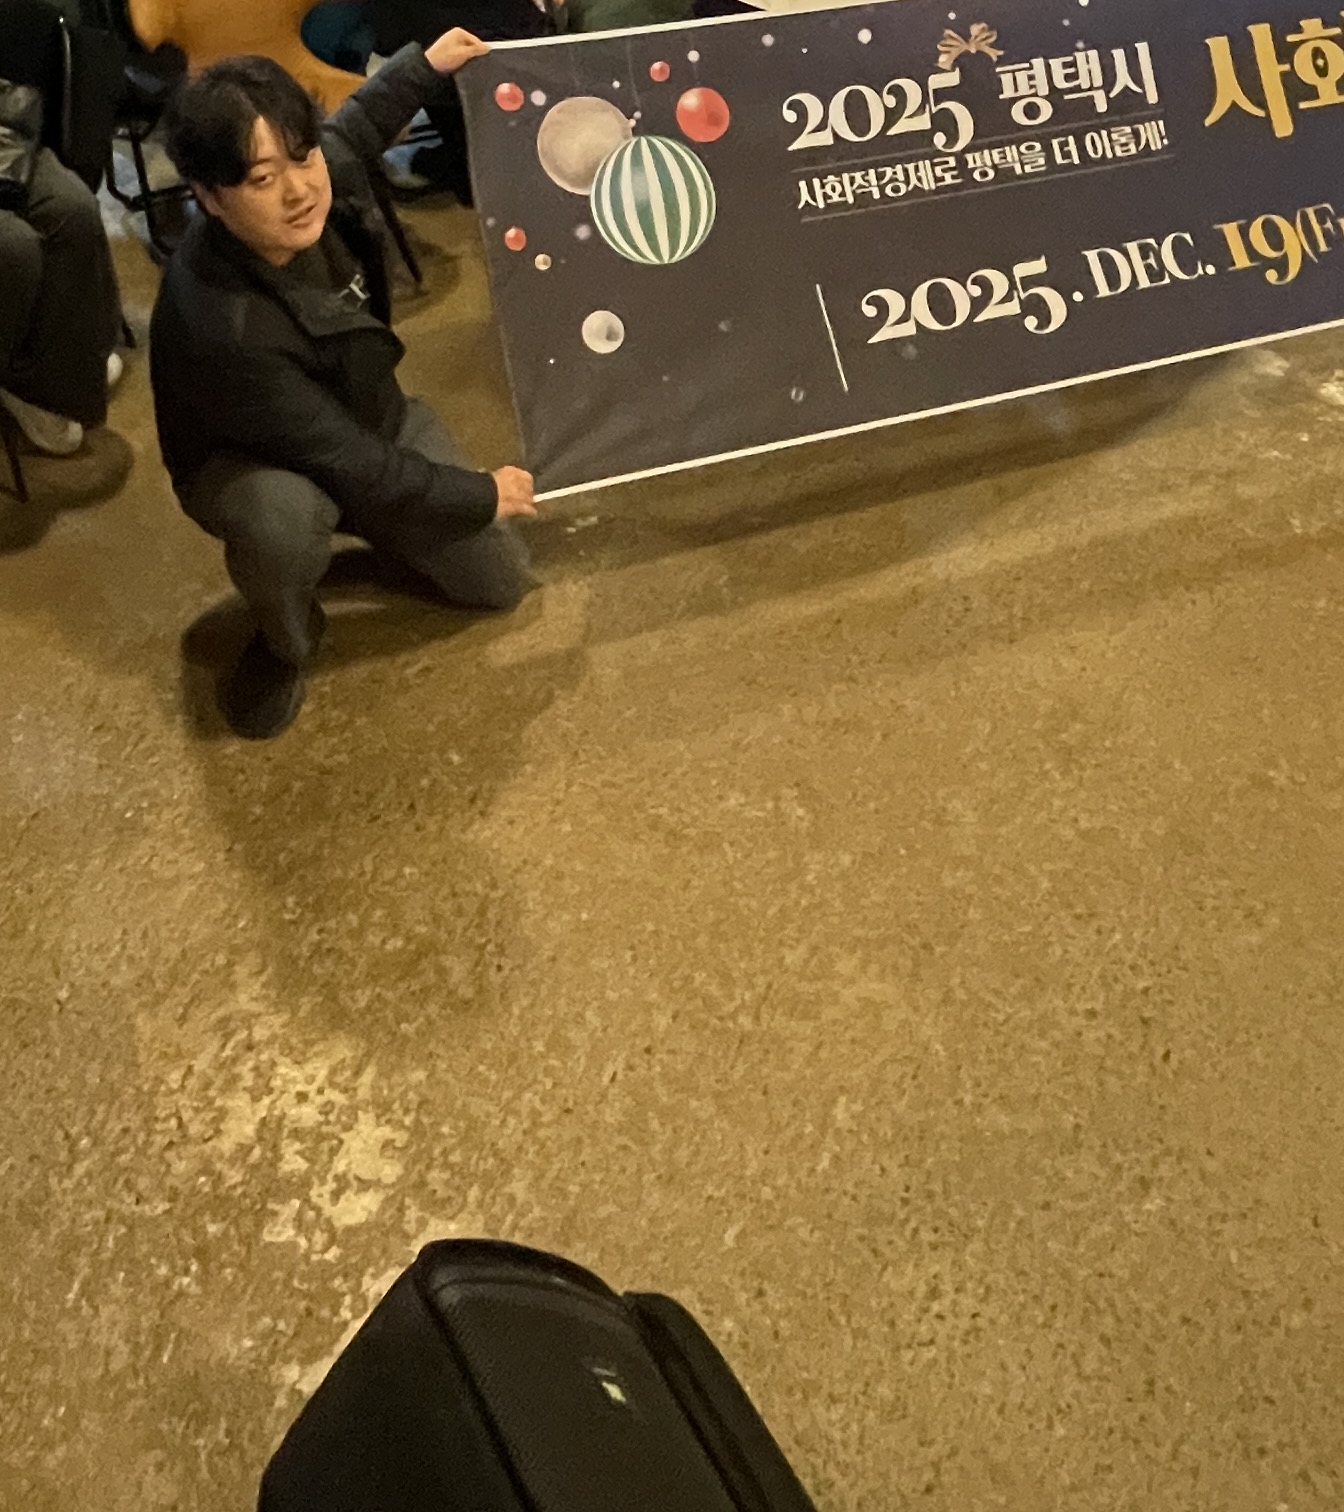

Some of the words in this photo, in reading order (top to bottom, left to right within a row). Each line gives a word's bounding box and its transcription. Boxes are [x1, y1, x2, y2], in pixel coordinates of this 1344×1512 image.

[781, 68, 975, 153] 2025
[995, 40, 1159, 127] 평택시
[796, 154, 965, 210] 사회적경제로
[965, 141, 1047, 182] 평택을
[1051, 134, 1081, 167] 더
